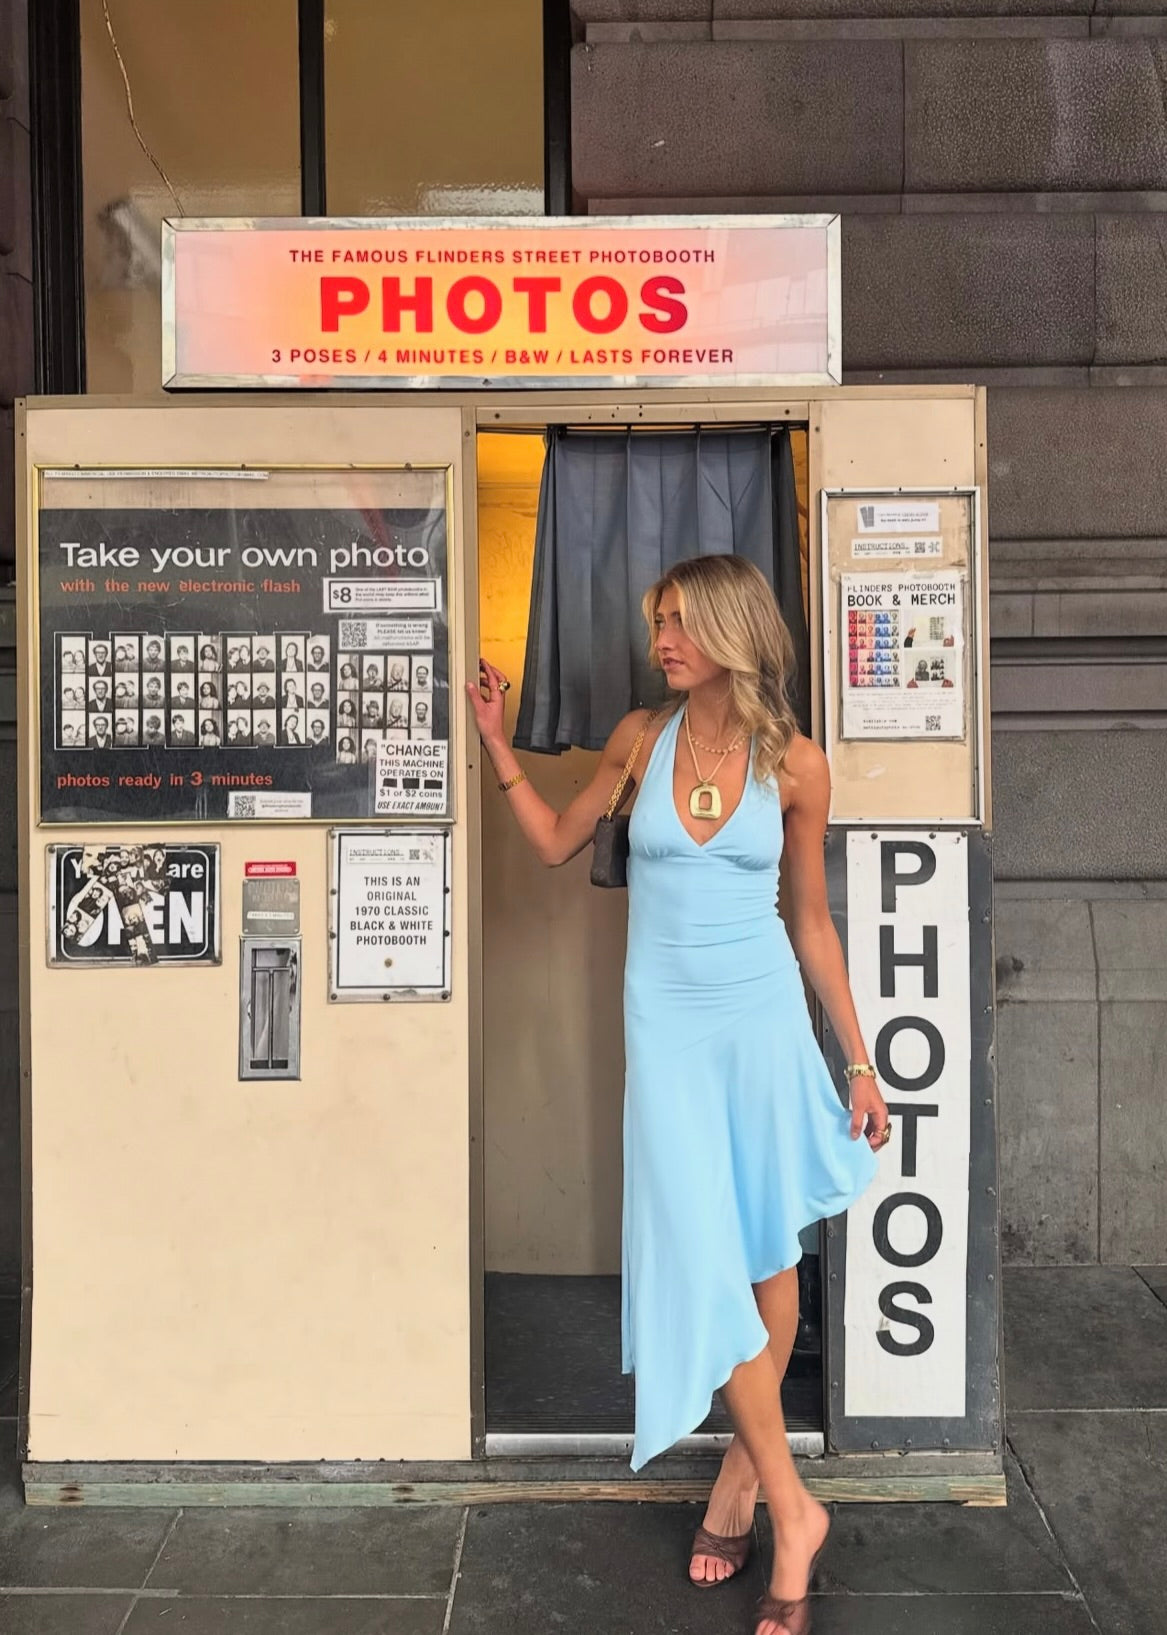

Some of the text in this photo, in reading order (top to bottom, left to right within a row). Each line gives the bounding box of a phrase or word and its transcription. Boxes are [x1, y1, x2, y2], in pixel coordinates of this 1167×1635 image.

[289, 249, 715, 263] THE FAMOUS FLINDERS STREET PHOTOBOOTH
[320, 275, 689, 334] PHOTOS
[272, 349, 734, 364] 3 POSES / 4 MINUTES / B&W / LASTS FOREVER
[59, 542, 429, 573] Take your own photo
[60, 578, 301, 593] with the new electronic flash
[898, 583, 956, 592] PHOTOBOOTH
[332, 587, 352, 603] $8
[848, 594, 956, 607] BOOK & MERCH
[381, 744, 446, 757] "CHANGE"
[380, 759, 444, 768] THIS MACHINE
[57, 771, 273, 789] photos ready in 3 minutes
[380, 769, 444, 778] OPERATES ON
[380, 788, 390, 796] $1
[405, 789, 416, 797] $2
[378, 801, 444, 810] USE EXACT AMOUNT
[168, 863, 204, 878] are
[364, 876, 420, 886] THIS IS AN
[367, 891, 417, 901] ORIGINAL
[355, 906, 429, 916] 1970 CLASSIC
[350, 921, 433, 931] BLACK & WHITE
[356, 935, 427, 946] PHOTOBOOTH
[872, 840, 945, 1357] PHOTOS
